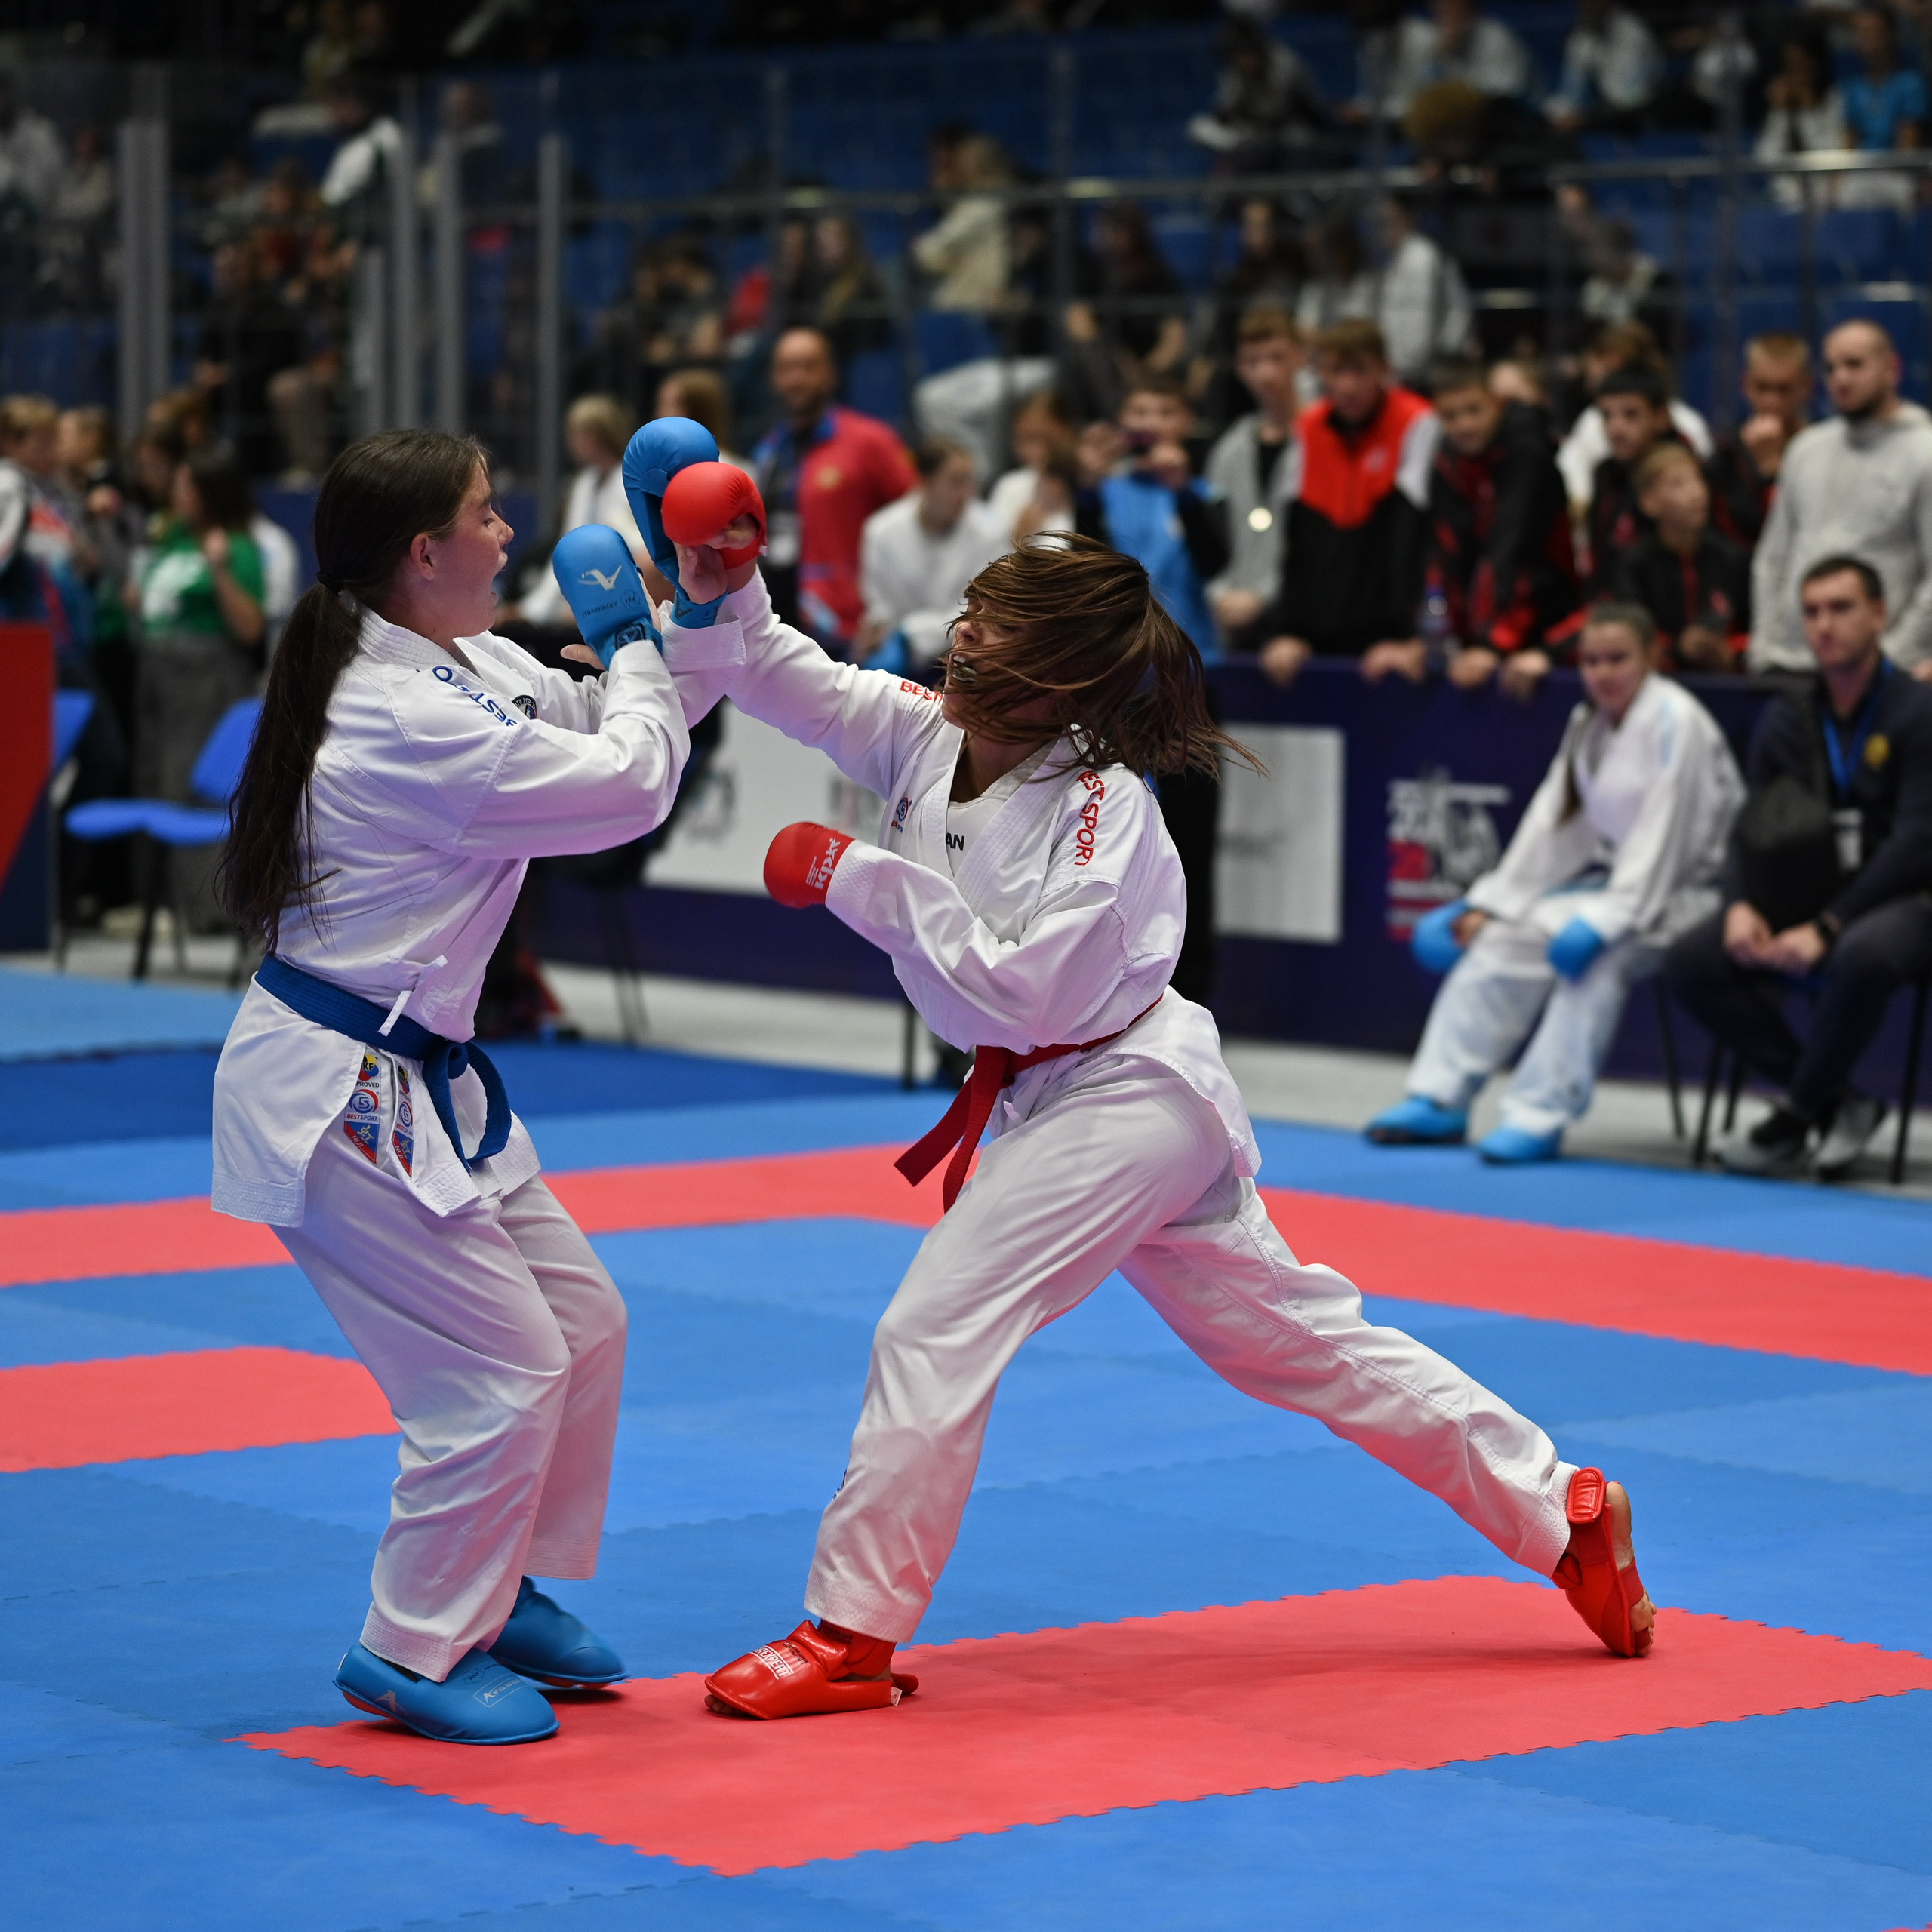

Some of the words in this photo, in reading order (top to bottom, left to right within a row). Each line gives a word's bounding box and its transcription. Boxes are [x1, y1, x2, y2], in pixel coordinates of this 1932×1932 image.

[1074, 803, 1100, 867] SPORT
[362, 1062, 374, 1071] KF
[352, 1134, 365, 1147] NIJI
[395, 1146, 404, 1159] NIJI
